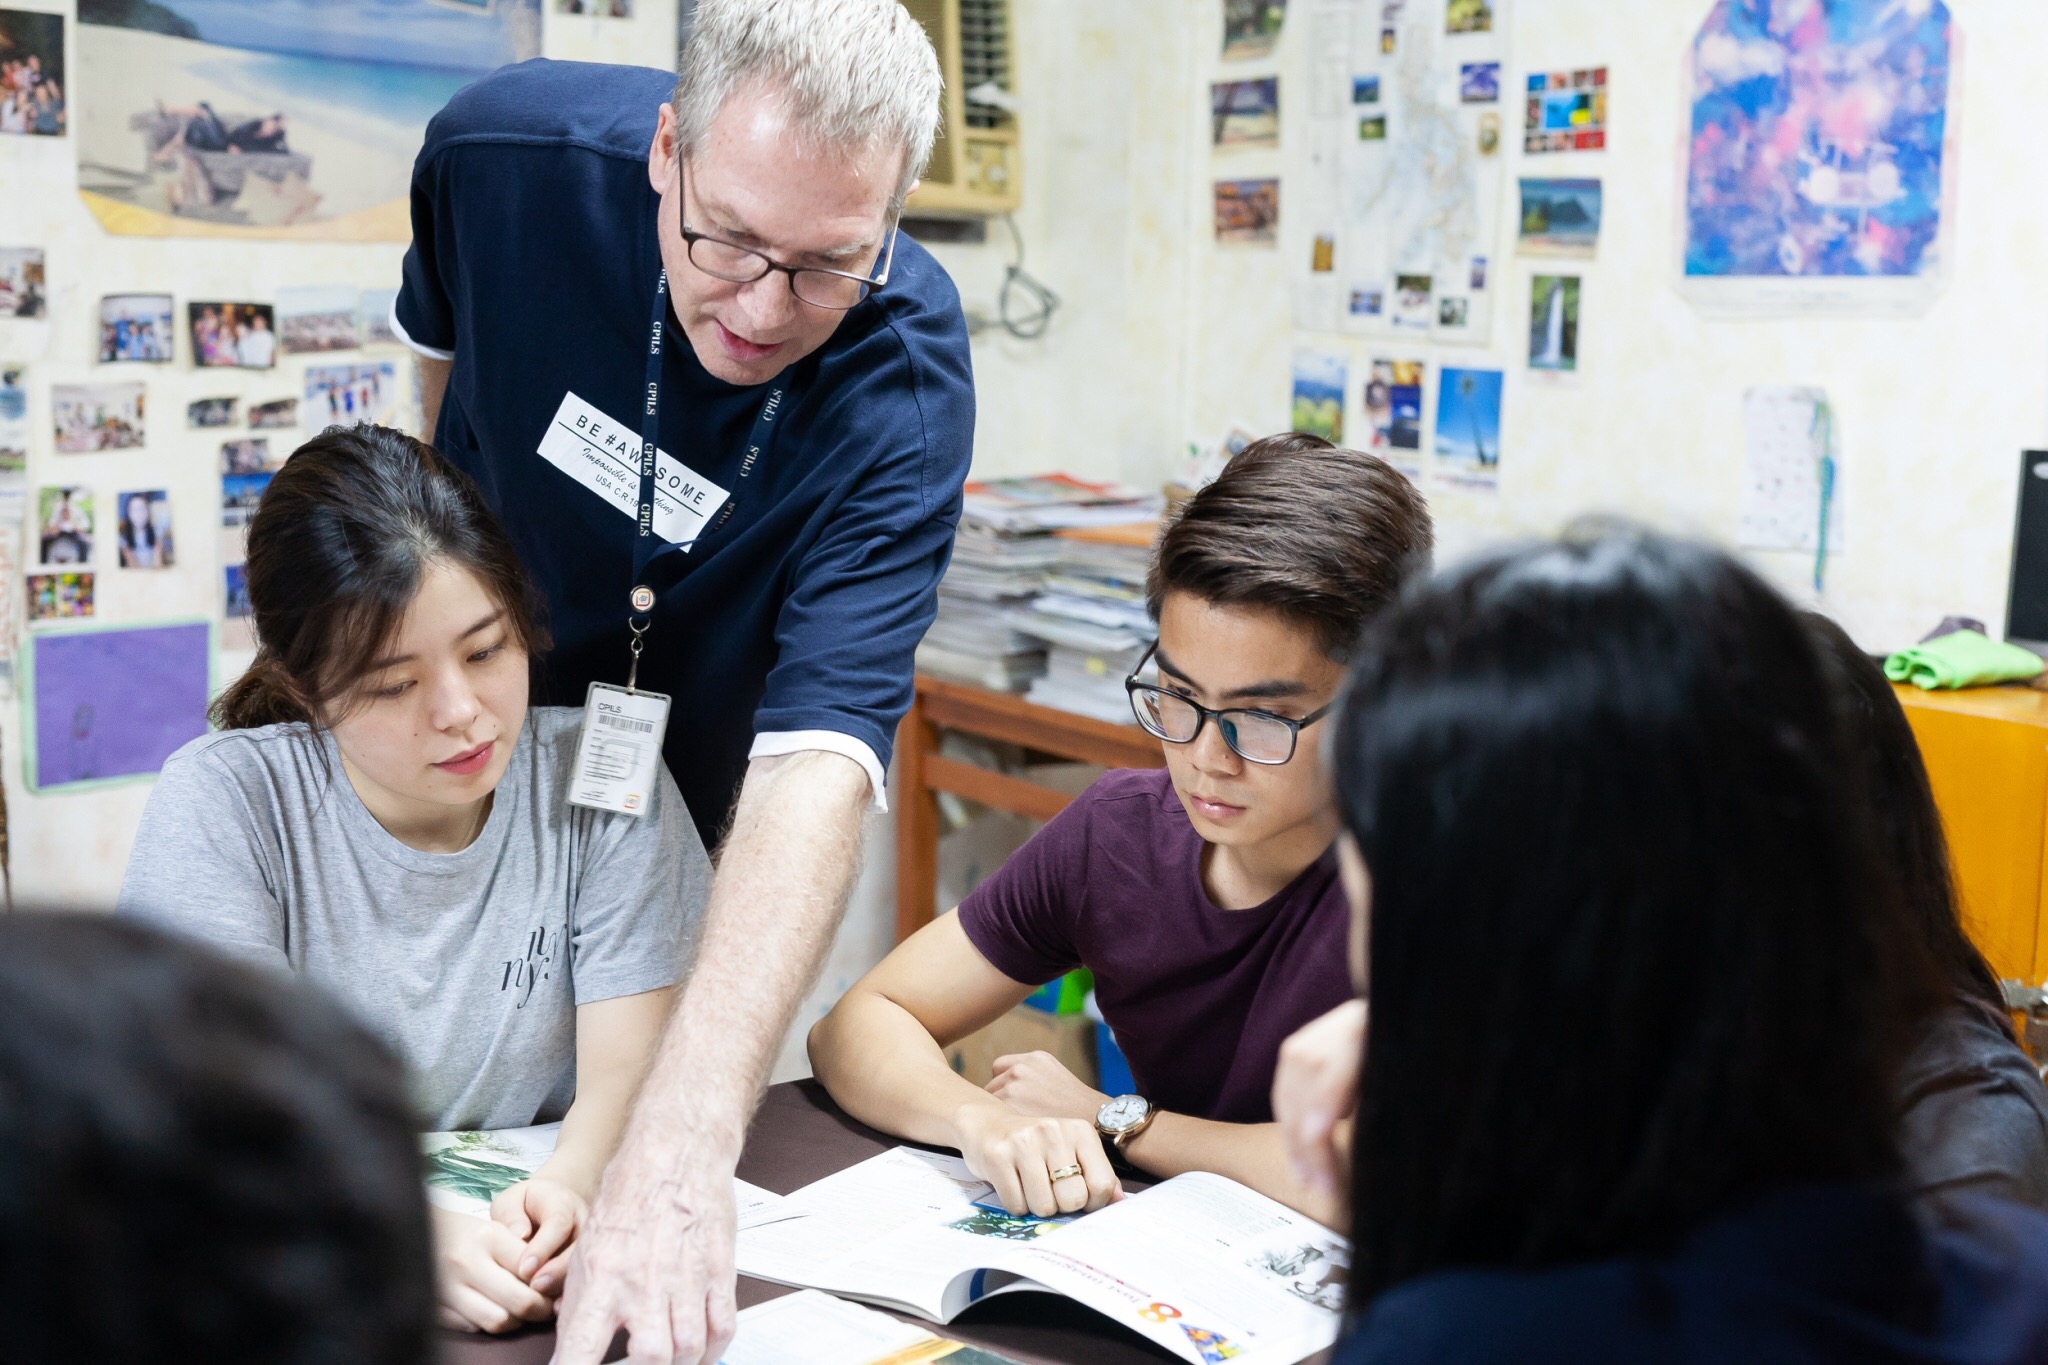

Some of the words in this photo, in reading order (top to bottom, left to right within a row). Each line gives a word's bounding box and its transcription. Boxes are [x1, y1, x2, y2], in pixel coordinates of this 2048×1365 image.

[657, 269, 666, 294] PILS
[650, 321, 662, 355] CPILS
[646, 382, 658, 416] CPILS
[762, 388, 783, 421] CPILS
[576, 415, 602, 437] BE
[604, 433, 706, 505] #AWSOME
[582, 447, 627, 483] Impossible
[627, 480, 637, 490] is
[643, 442, 654, 476] CPILS
[739, 445, 760, 477] CPILS
[595, 474, 612, 490] USA
[639, 503, 651, 537] CPILS
[598, 702, 622, 713] CPILS
[1138, 1302, 1182, 1323] 8
